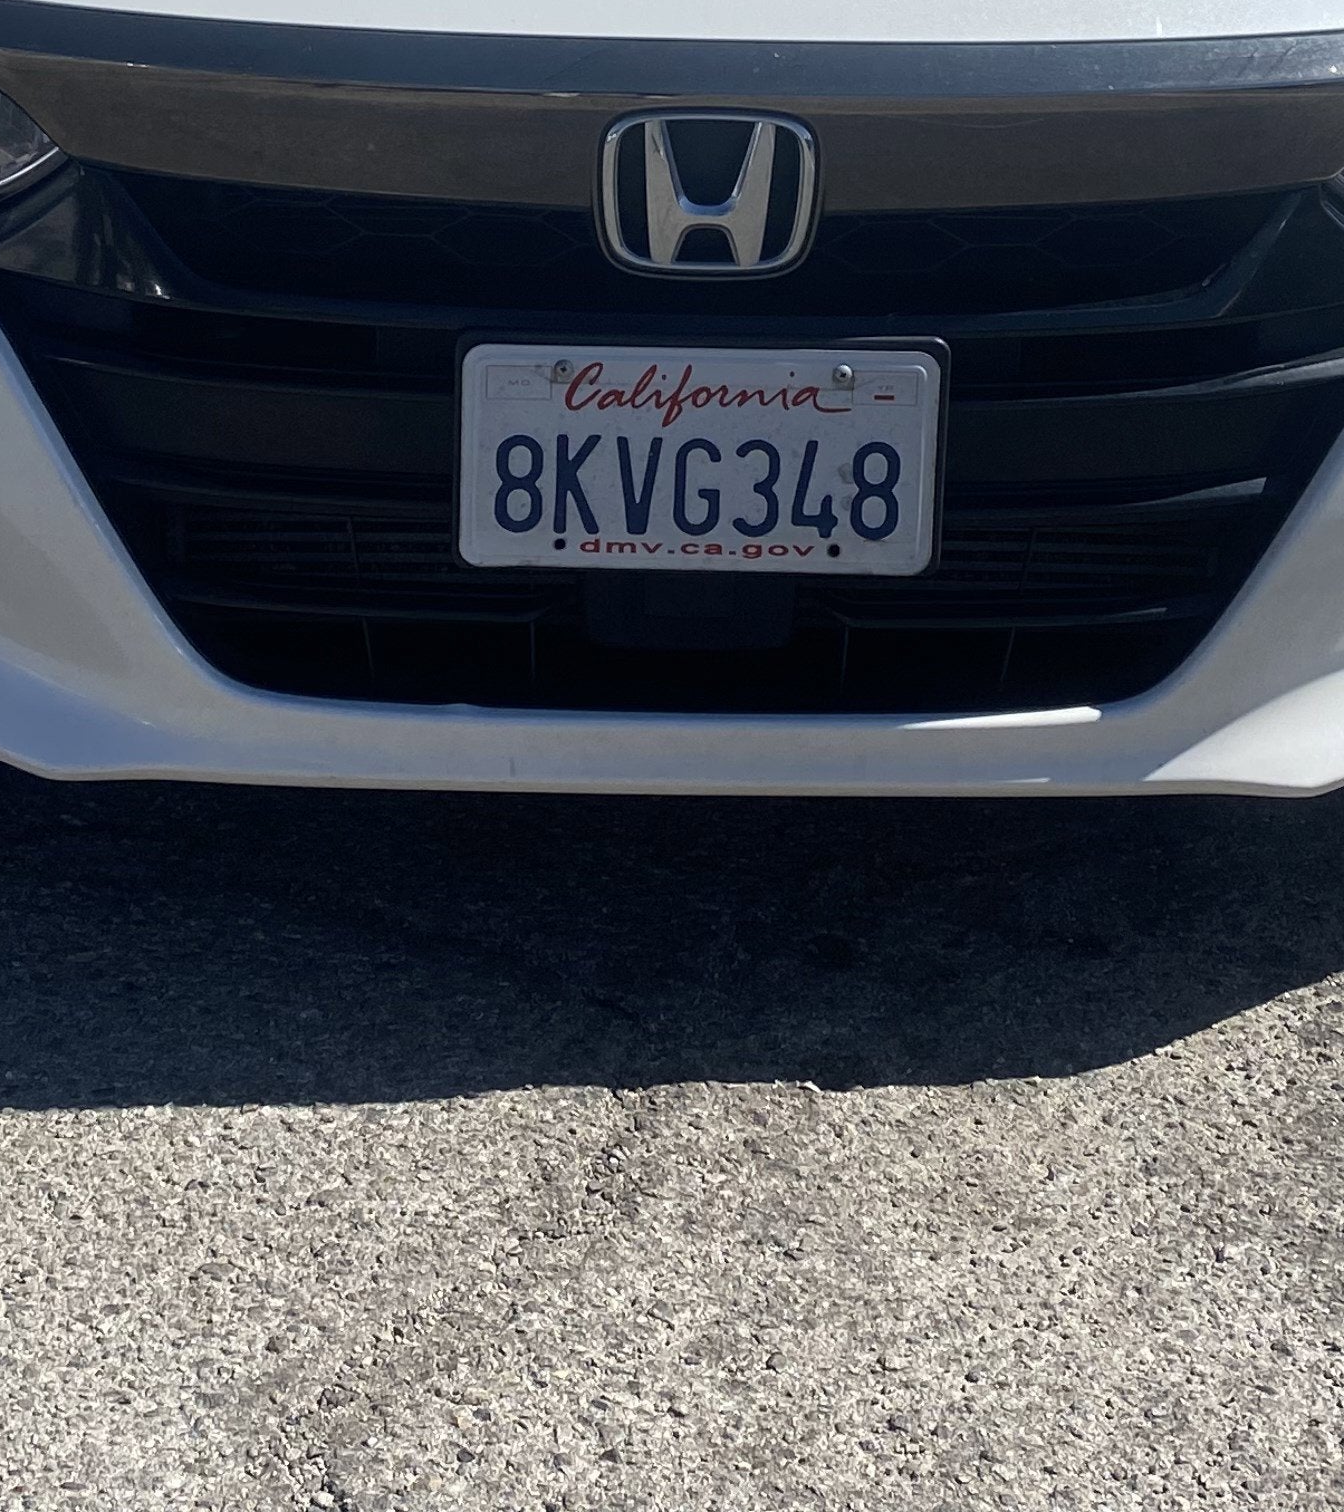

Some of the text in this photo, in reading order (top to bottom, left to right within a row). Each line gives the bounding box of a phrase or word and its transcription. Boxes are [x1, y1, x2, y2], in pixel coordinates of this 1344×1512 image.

[565, 361, 852, 427] California
[493, 434, 901, 541] 8KVG348
[579, 538, 816, 559] dmv.ca.gov
